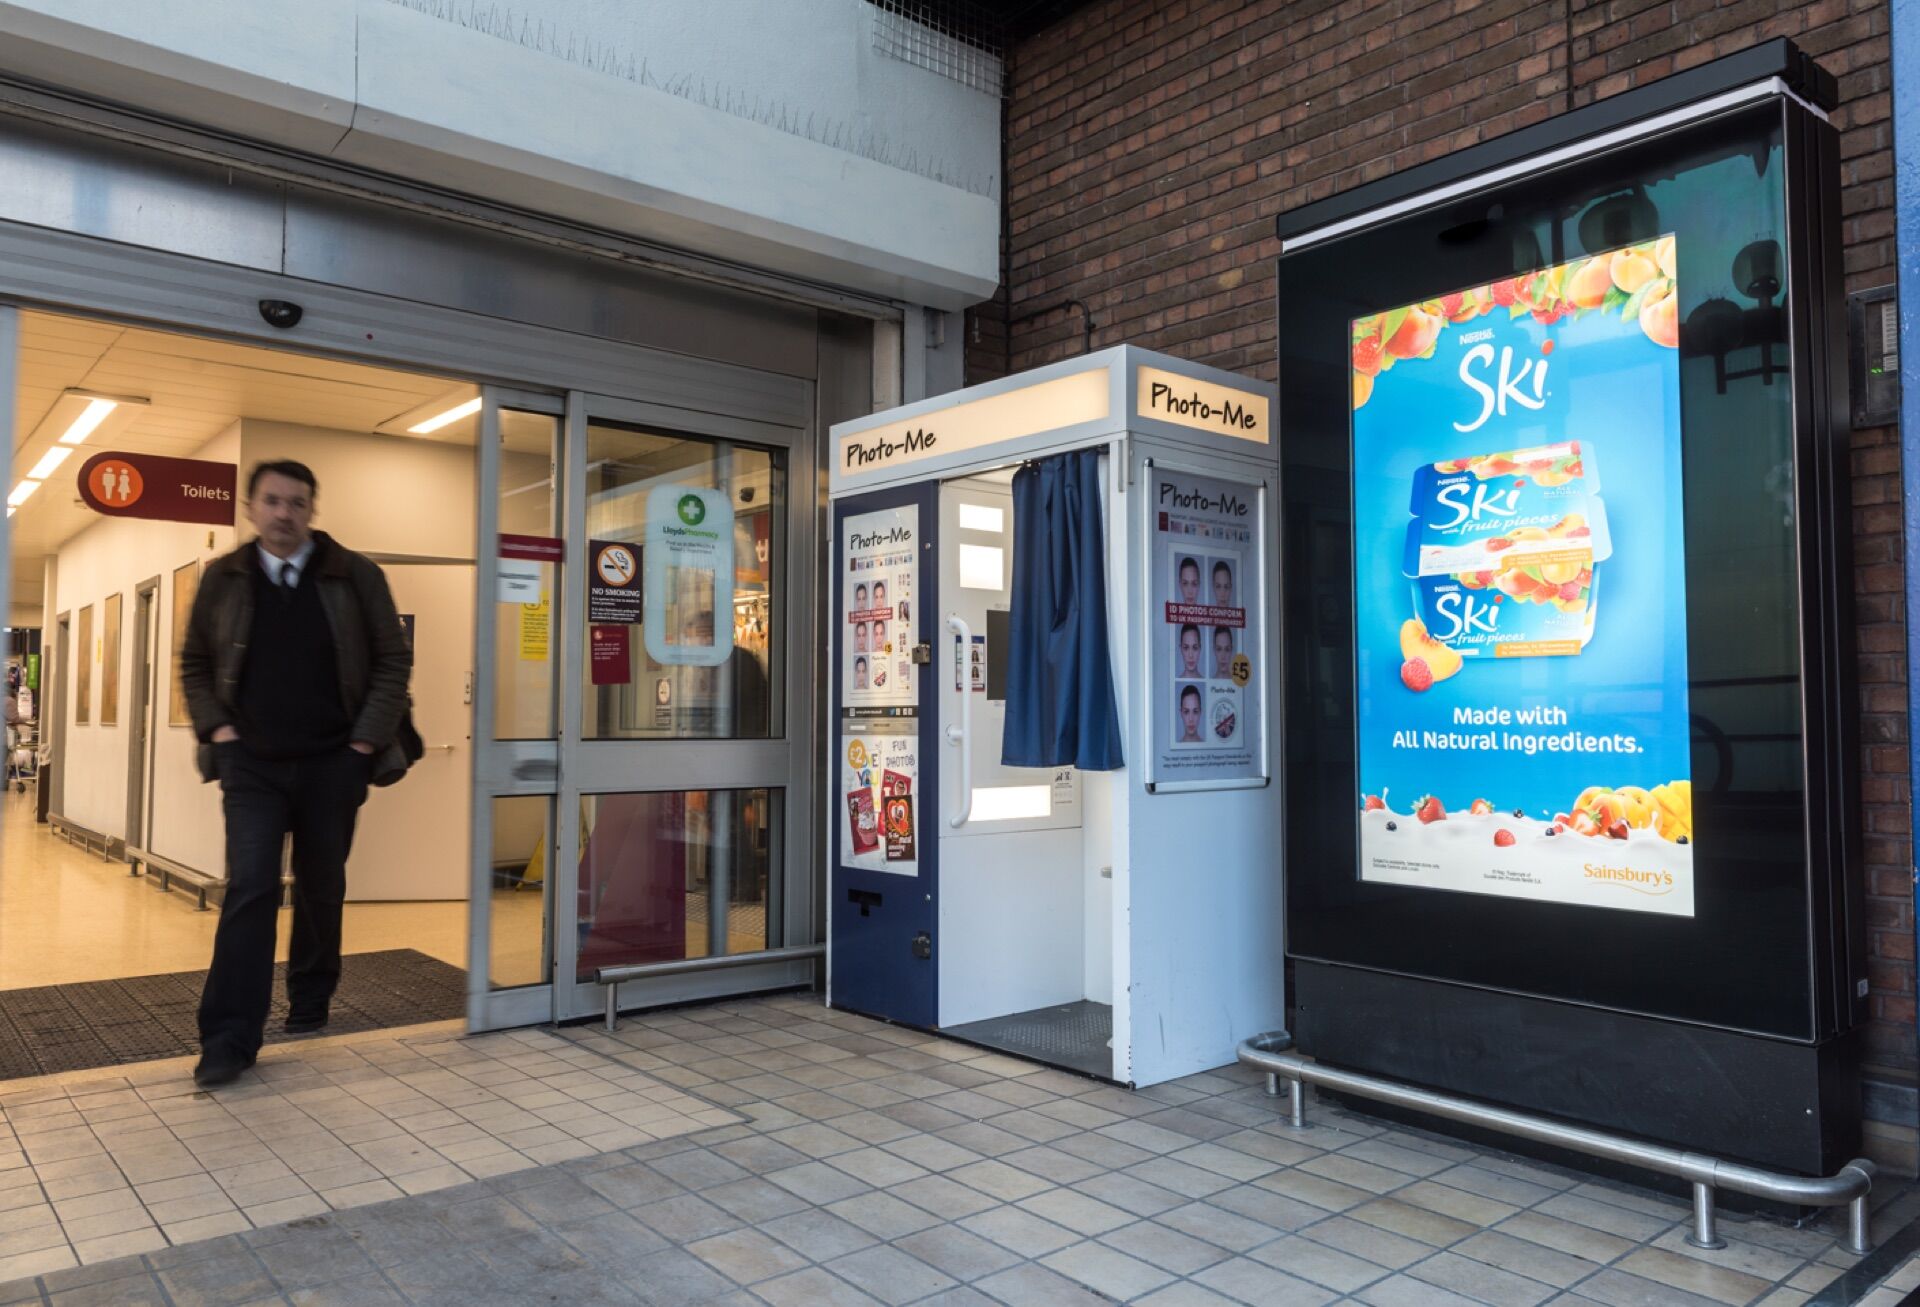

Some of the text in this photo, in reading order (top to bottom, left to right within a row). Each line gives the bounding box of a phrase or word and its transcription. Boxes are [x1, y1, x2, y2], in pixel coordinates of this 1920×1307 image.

[1151, 382, 1257, 430] Photo-Me
[846, 428, 937, 468] Photo-Me
[180, 484, 231, 501] Toilets
[1160, 482, 1248, 517] Photo-Me
[1460, 513, 1560, 535] fruit pieces
[850, 527, 912, 550] Photo-Me
[591, 587, 640, 597] NO SMOKING
[1179, 606, 1208, 616] PHOTOS
[1209, 608, 1243, 619] CONFORM
[1456, 631, 1526, 646] fruit pieces
[1232, 662, 1250, 681] £5
[1453, 706, 1568, 725] Made with
[1392, 731, 1645, 755] All Natural Ingredients.
[1583, 863, 1673, 887] Sainsbury's
